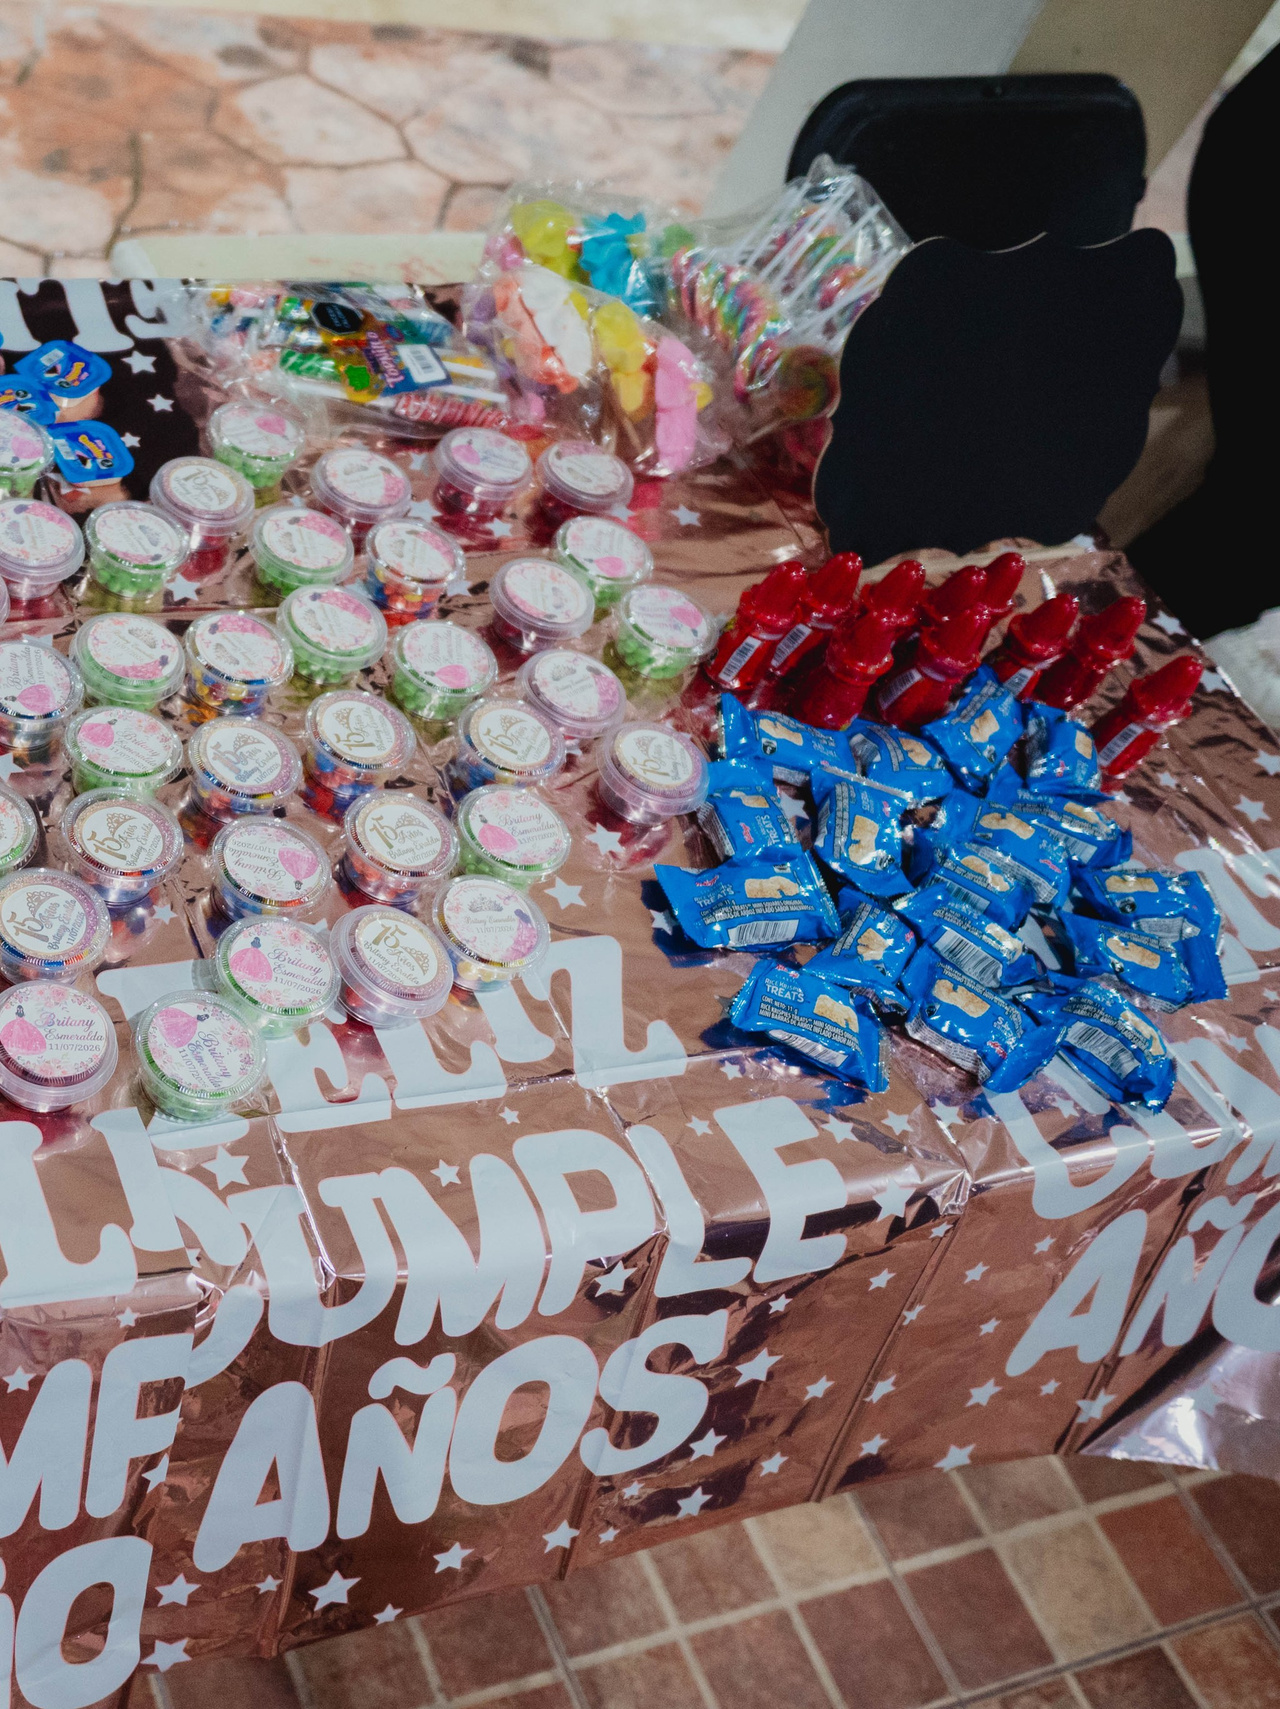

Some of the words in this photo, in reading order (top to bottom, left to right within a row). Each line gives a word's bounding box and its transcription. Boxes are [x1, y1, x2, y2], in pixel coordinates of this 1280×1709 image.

[369, 815, 398, 850] 15
[498, 811, 543, 827] Britany
[86, 830, 127, 861] 15
[233, 858, 287, 881] Britany
[6, 911, 50, 943] 15
[66, 912, 85, 946] 11/07/2026
[372, 922, 408, 949] 15
[267, 948, 323, 976] Britany
[272, 962, 327, 987] Esmeralda
[274, 976, 322, 995] 11/07/2026
[765, 983, 804, 1003] TREATS
[35, 1011, 96, 1032] Britany
[43, 1028, 105, 1041] Esmeralda
[49, 1043, 100, 1051] 11/07/2026
[198, 1031, 232, 1079] Britany
[187, 1039, 221, 1089] Esmeralda
[193, 1309, 728, 1572] AÑOS
